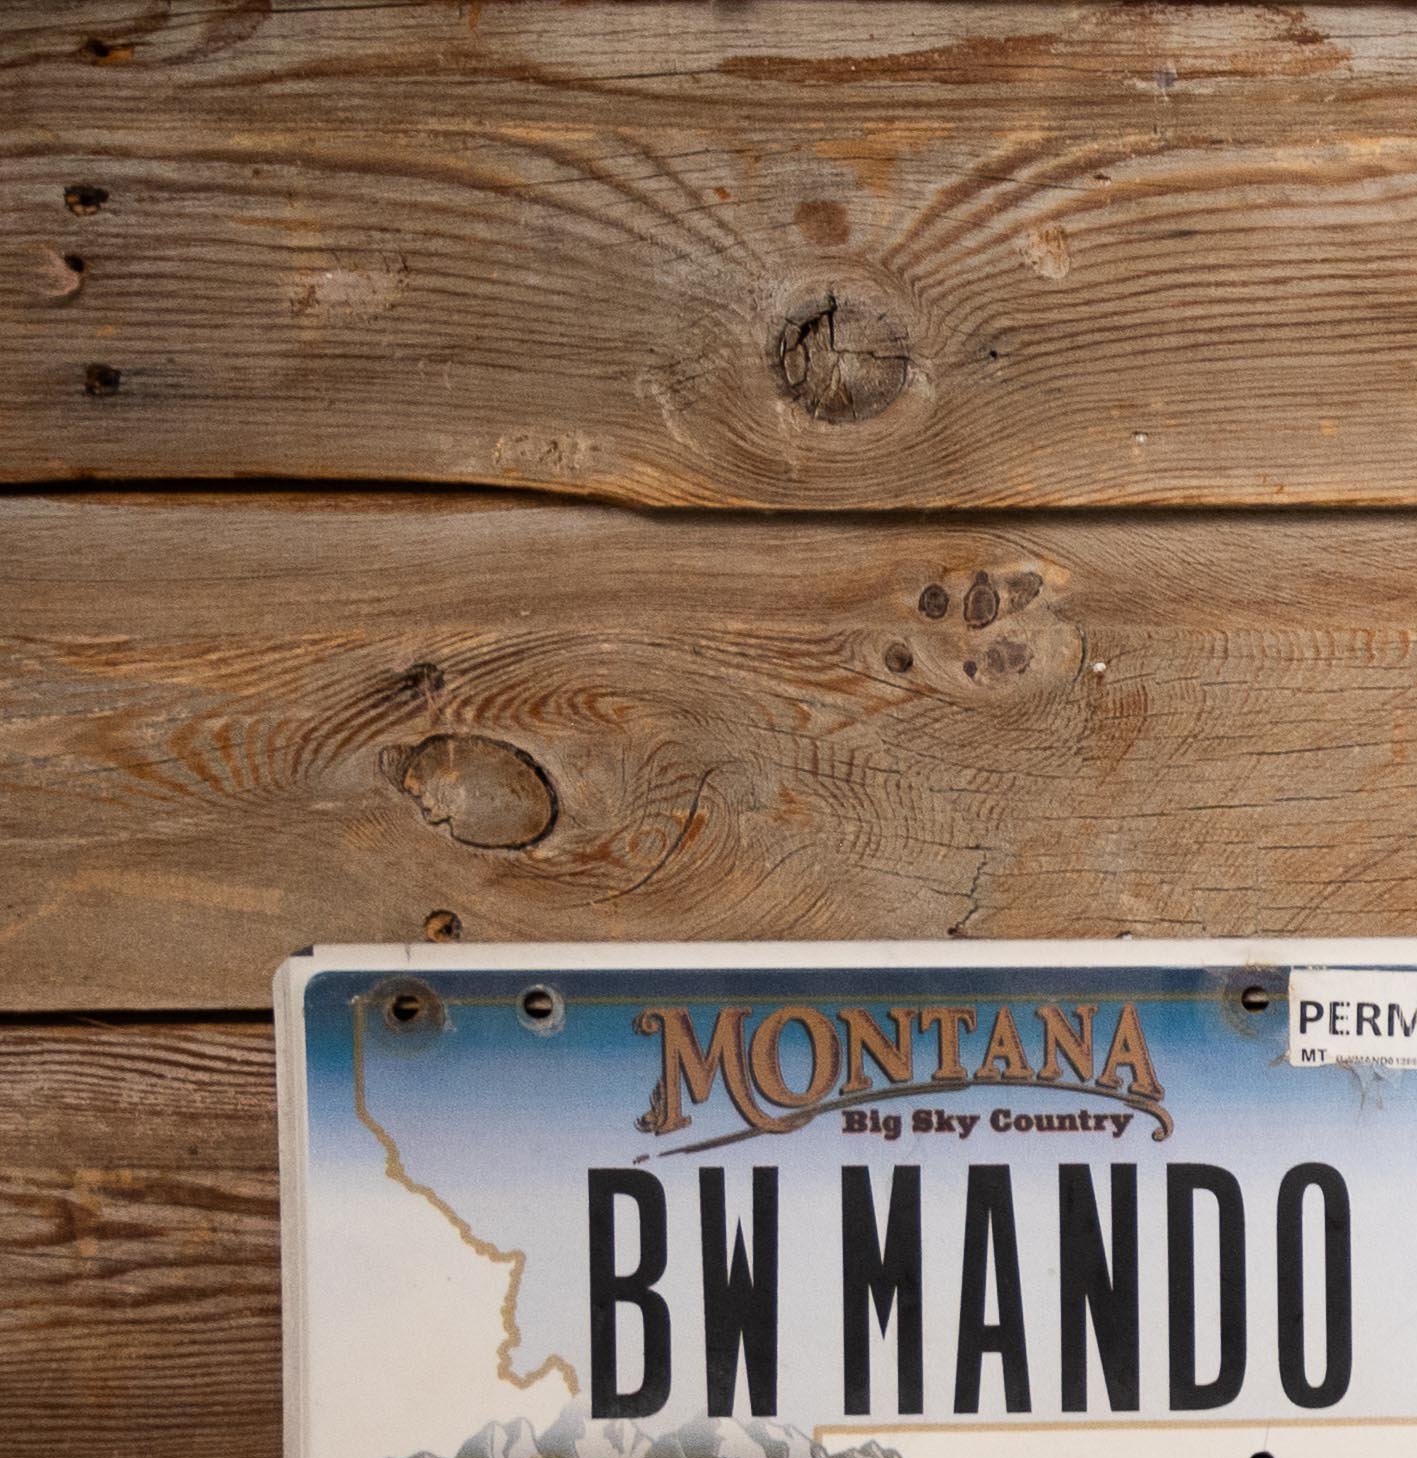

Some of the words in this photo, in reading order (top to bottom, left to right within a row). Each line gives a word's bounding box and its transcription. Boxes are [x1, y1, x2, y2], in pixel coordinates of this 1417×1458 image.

[632, 1002, 1166, 1136] MONTANA
[1301, 1048, 1328, 1063] MT
[841, 1108, 902, 1141] Big
[911, 1108, 981, 1140] Sky
[989, 1107, 1134, 1138] Country
[587, 1165, 779, 1420] BW
[840, 1161, 1353, 1416] MANDO
